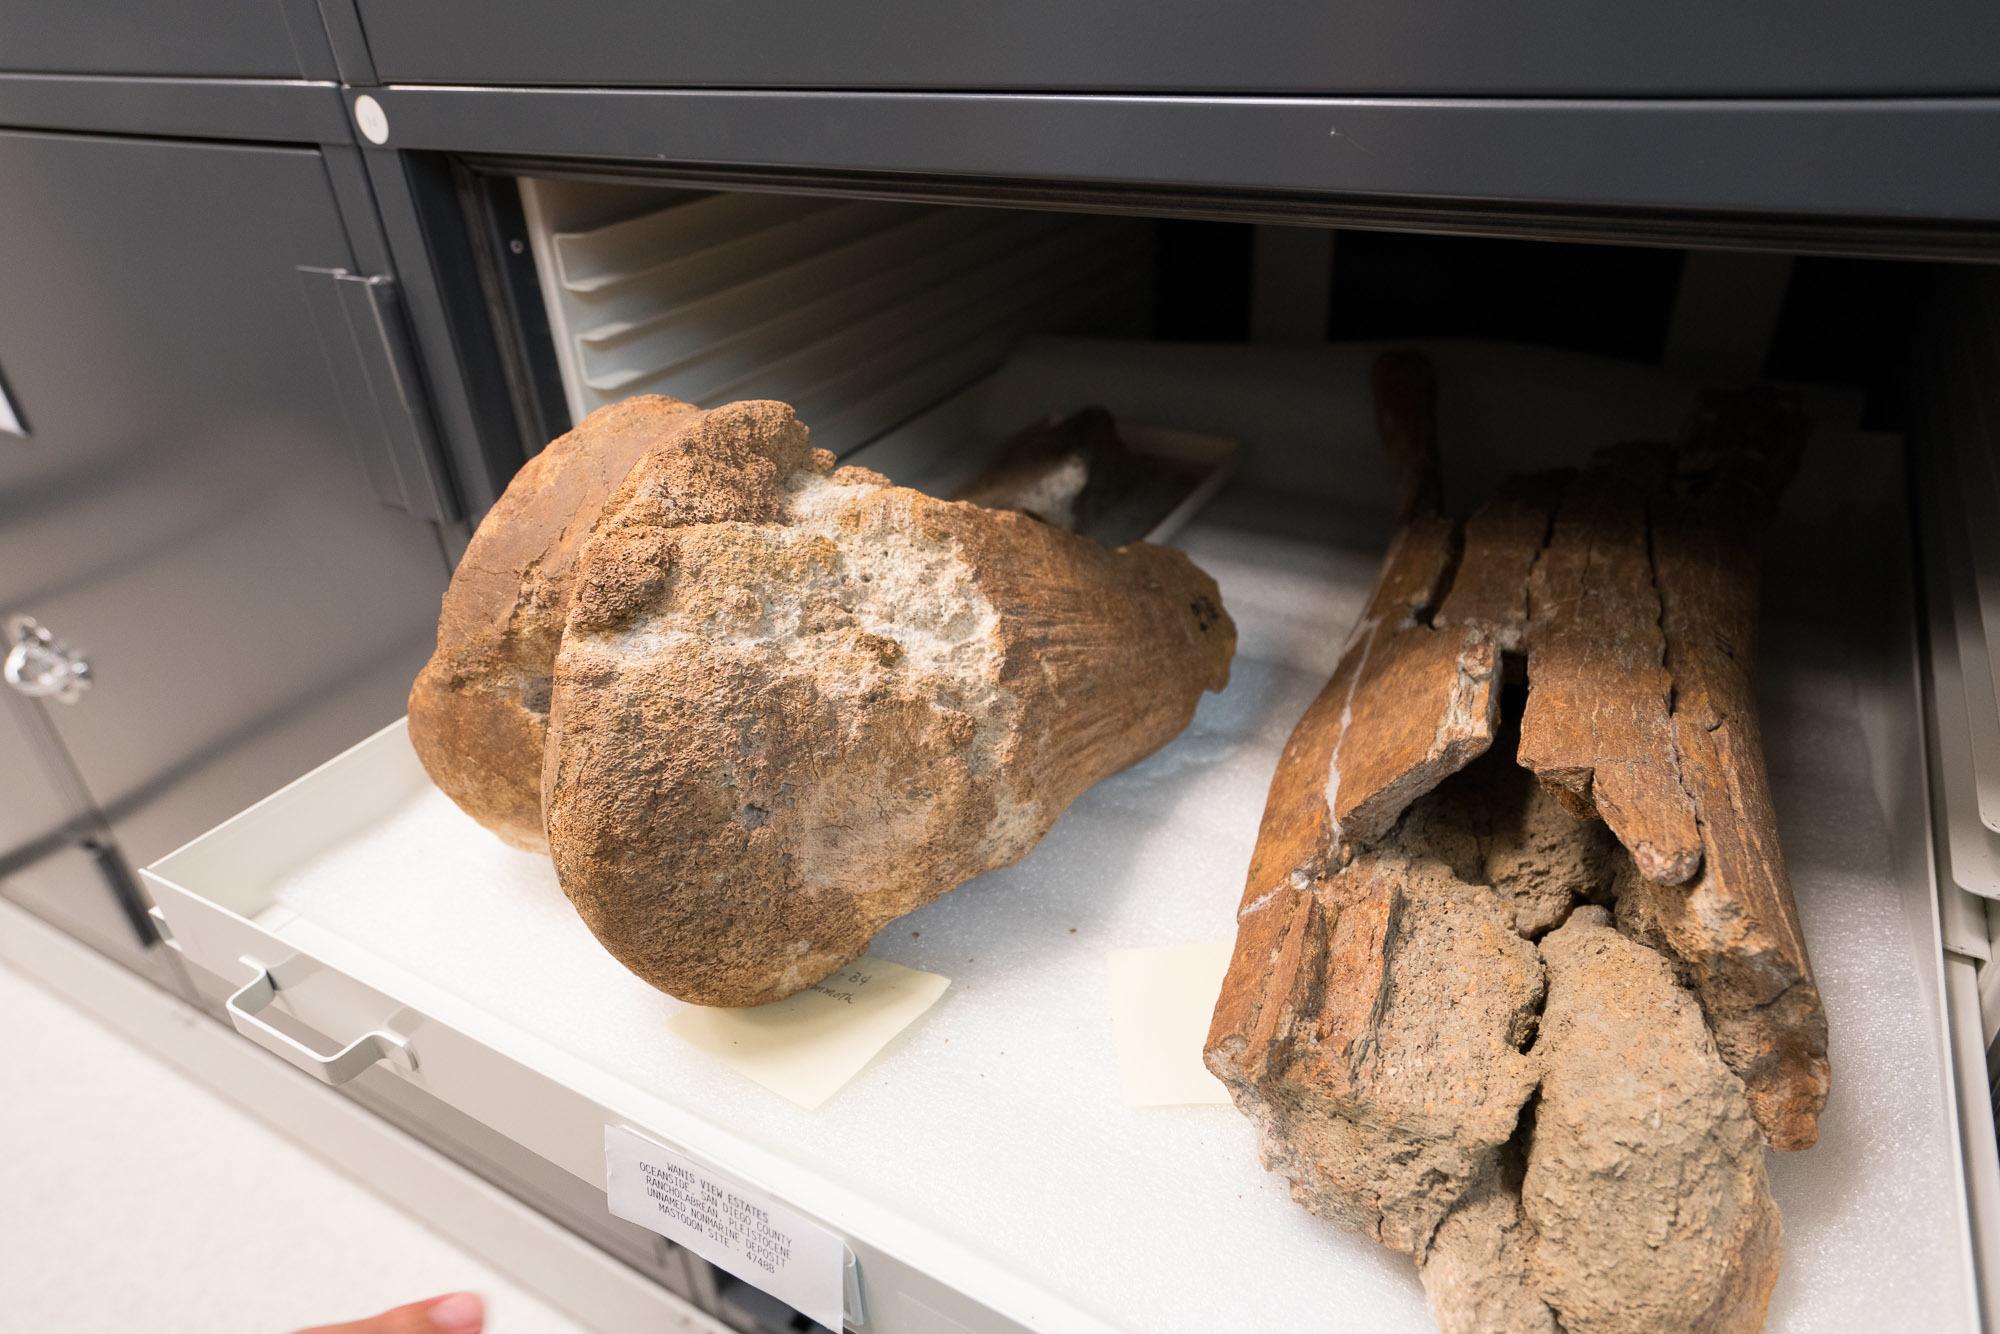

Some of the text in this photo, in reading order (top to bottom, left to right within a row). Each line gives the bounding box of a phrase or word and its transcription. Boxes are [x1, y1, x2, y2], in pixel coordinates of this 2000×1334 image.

[667, 1162, 769, 1224] WANIS VIEW ESTATES
[700, 1191, 718, 1207] SAN
[722, 1202, 751, 1226] DIEGO
[756, 1221, 792, 1248] COUNTY
[646, 1186, 786, 1267] UNNAMED NONMARINE DEPOSIT
[658, 1203, 703, 1233] MASTODON
[708, 1228, 730, 1248] SITE
[728, 1218, 792, 1260] PLEISTOCENE
